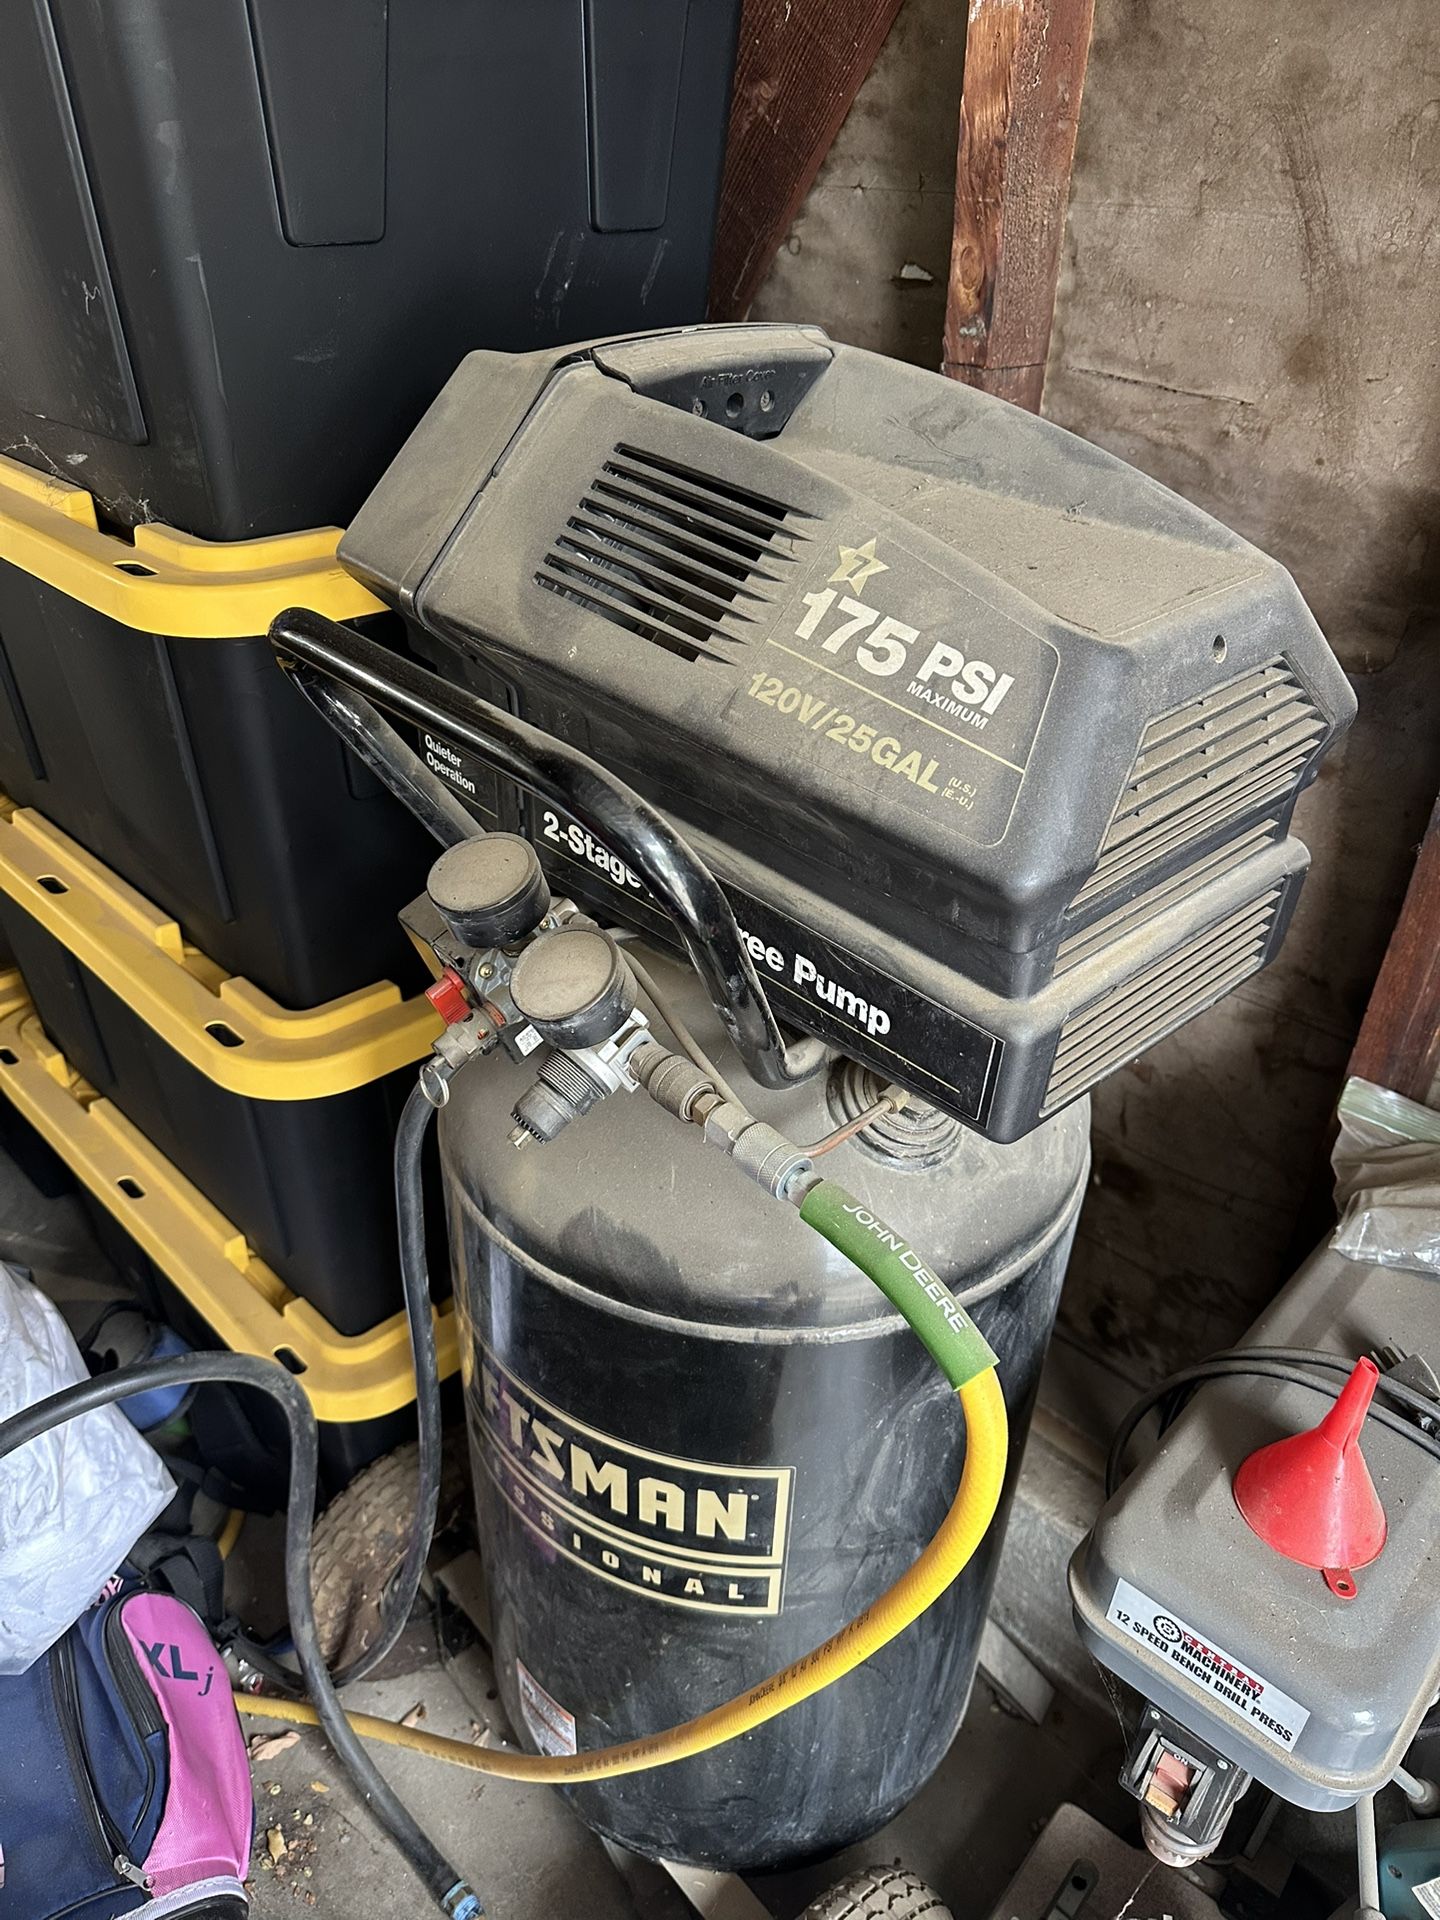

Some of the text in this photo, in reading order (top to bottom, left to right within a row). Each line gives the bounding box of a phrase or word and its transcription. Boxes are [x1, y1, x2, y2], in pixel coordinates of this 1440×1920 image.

[846, 554, 871, 579] 7
[795, 587, 1015, 715] 175 PSI
[748, 672, 940, 794] 120V/25GAL
[906, 680, 989, 730] MAXIMUM
[424, 734, 462, 767] Quieter
[426, 752, 476, 794] Operation
[739, 927, 785, 972] ree
[793, 953, 892, 1036] Pump
[842, 1203, 969, 1334] JOHN DEERE
[481, 1361, 749, 1541] FTSMAN
[1116, 1609, 1294, 1743] 12 SPEED BENCH DRILL PRESS
[1181, 1640, 1261, 1701] MACHINERY
[1183, 1633, 1262, 1692] CENTRAL
[1173, 1753, 1189, 1766] ON
